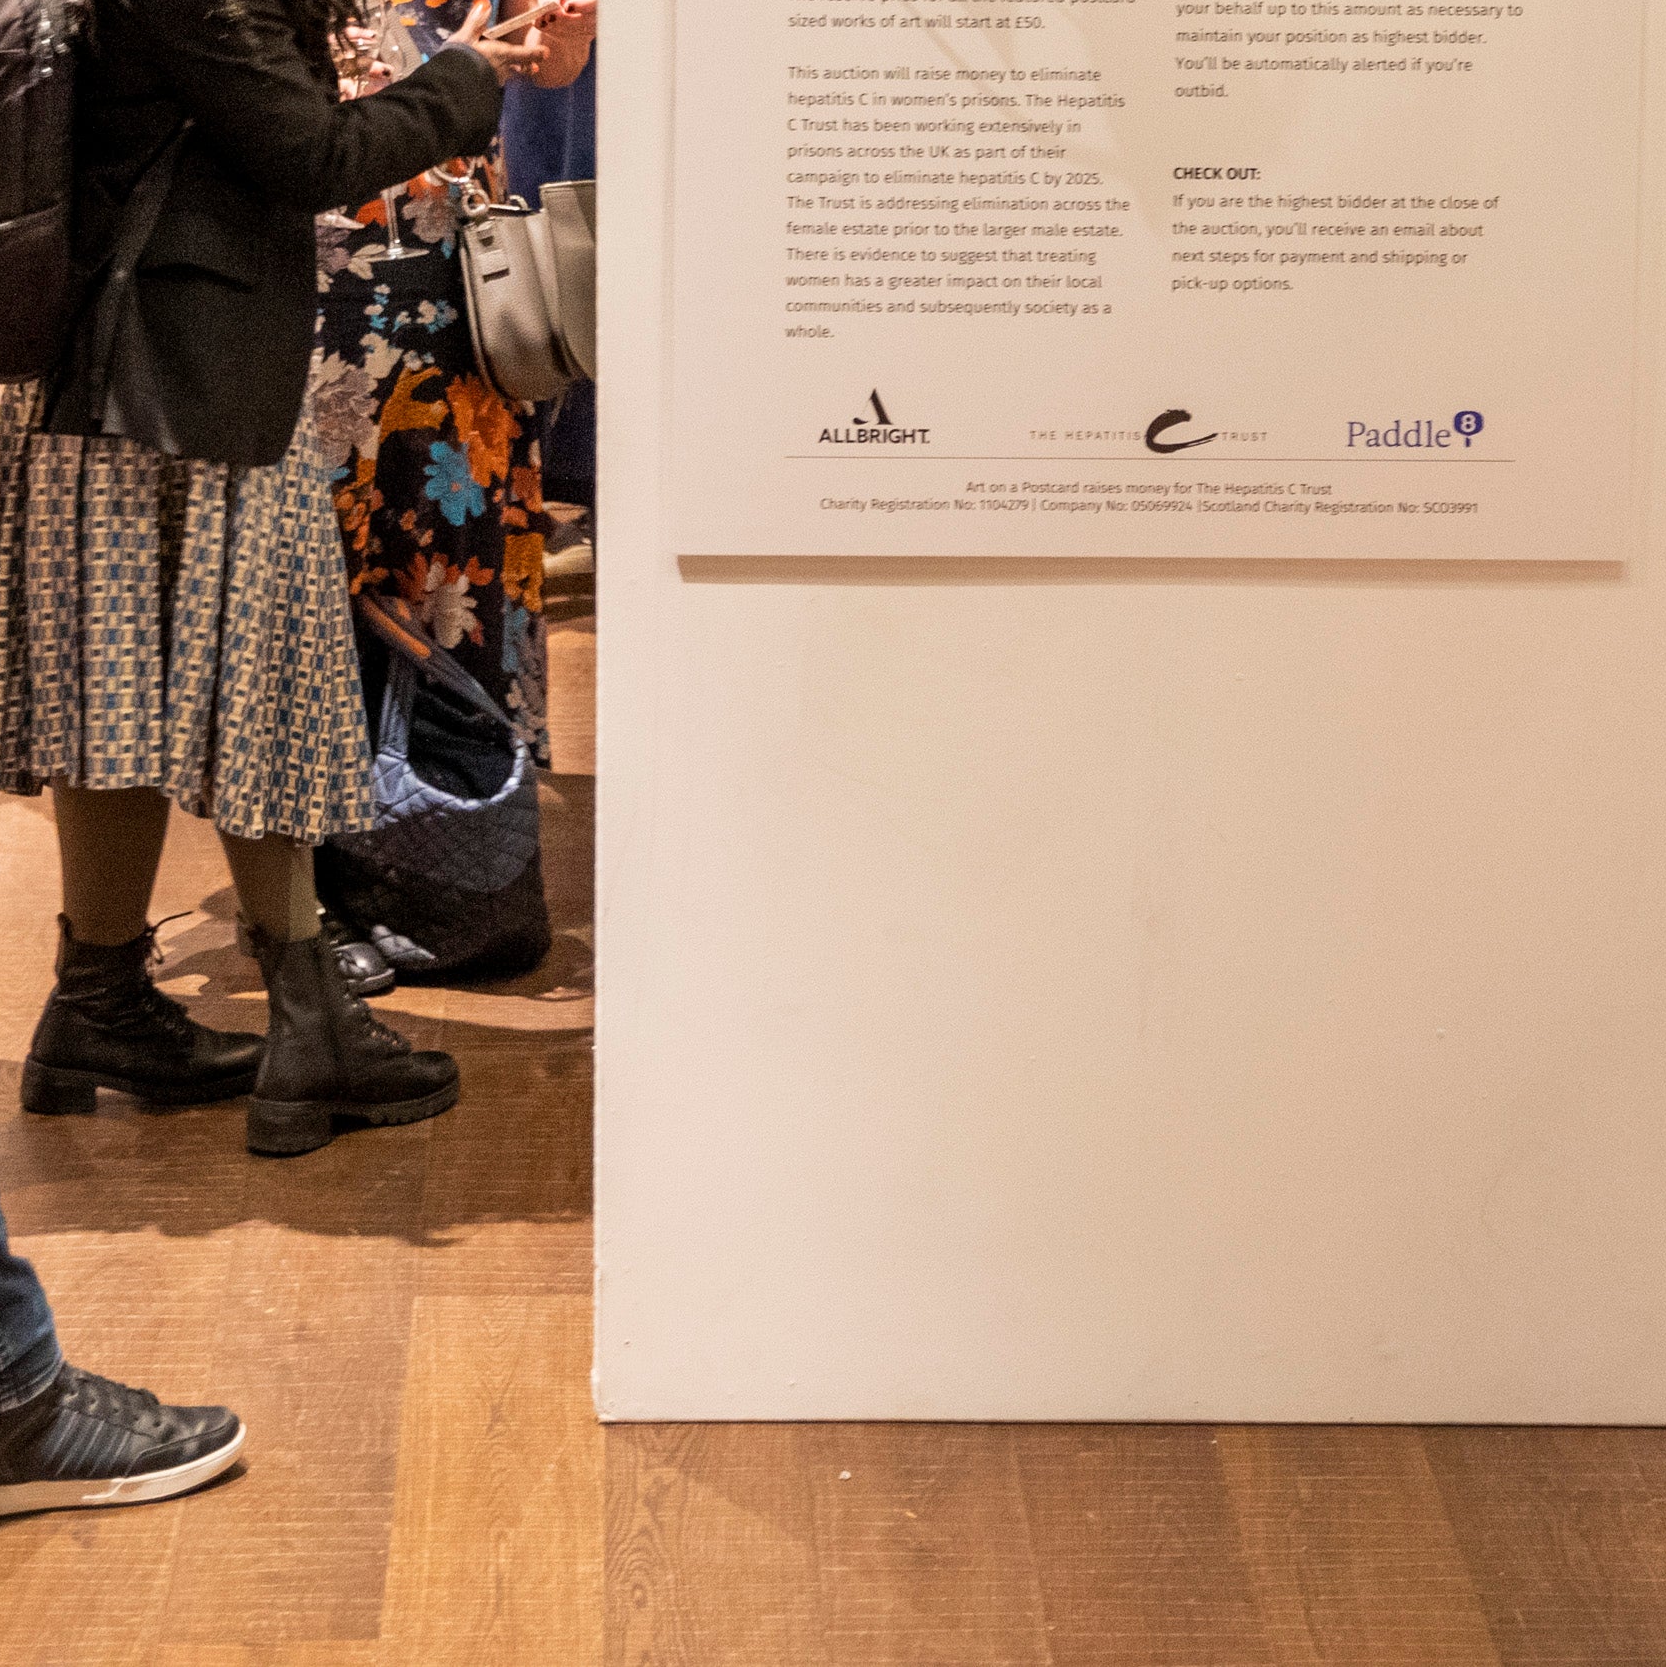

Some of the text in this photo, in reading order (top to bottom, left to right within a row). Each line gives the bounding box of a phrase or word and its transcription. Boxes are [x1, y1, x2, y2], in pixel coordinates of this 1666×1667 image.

[788, 12, 827, 26] sized
[831, 12, 875, 27] works
[879, 12, 895, 27] of
[899, 14, 923, 27] art
[923, 13, 951, 27] will
[956, 14, 992, 27] start
[995, 14, 1010, 27] at
[1221, 55, 1240, 69] be
[1244, 55, 1348, 74] automatically
[1352, 56, 1407, 70] alerted
[1410, 56, 1422, 70] if
[1172, 166, 1260, 180] CHECK OUT:
[1171, 275, 1293, 294] pick-up options.
[1030, 430, 1056, 440] THE
[1065, 431, 1141, 441] HEPATITIS
[1222, 432, 1268, 442] TRUST
